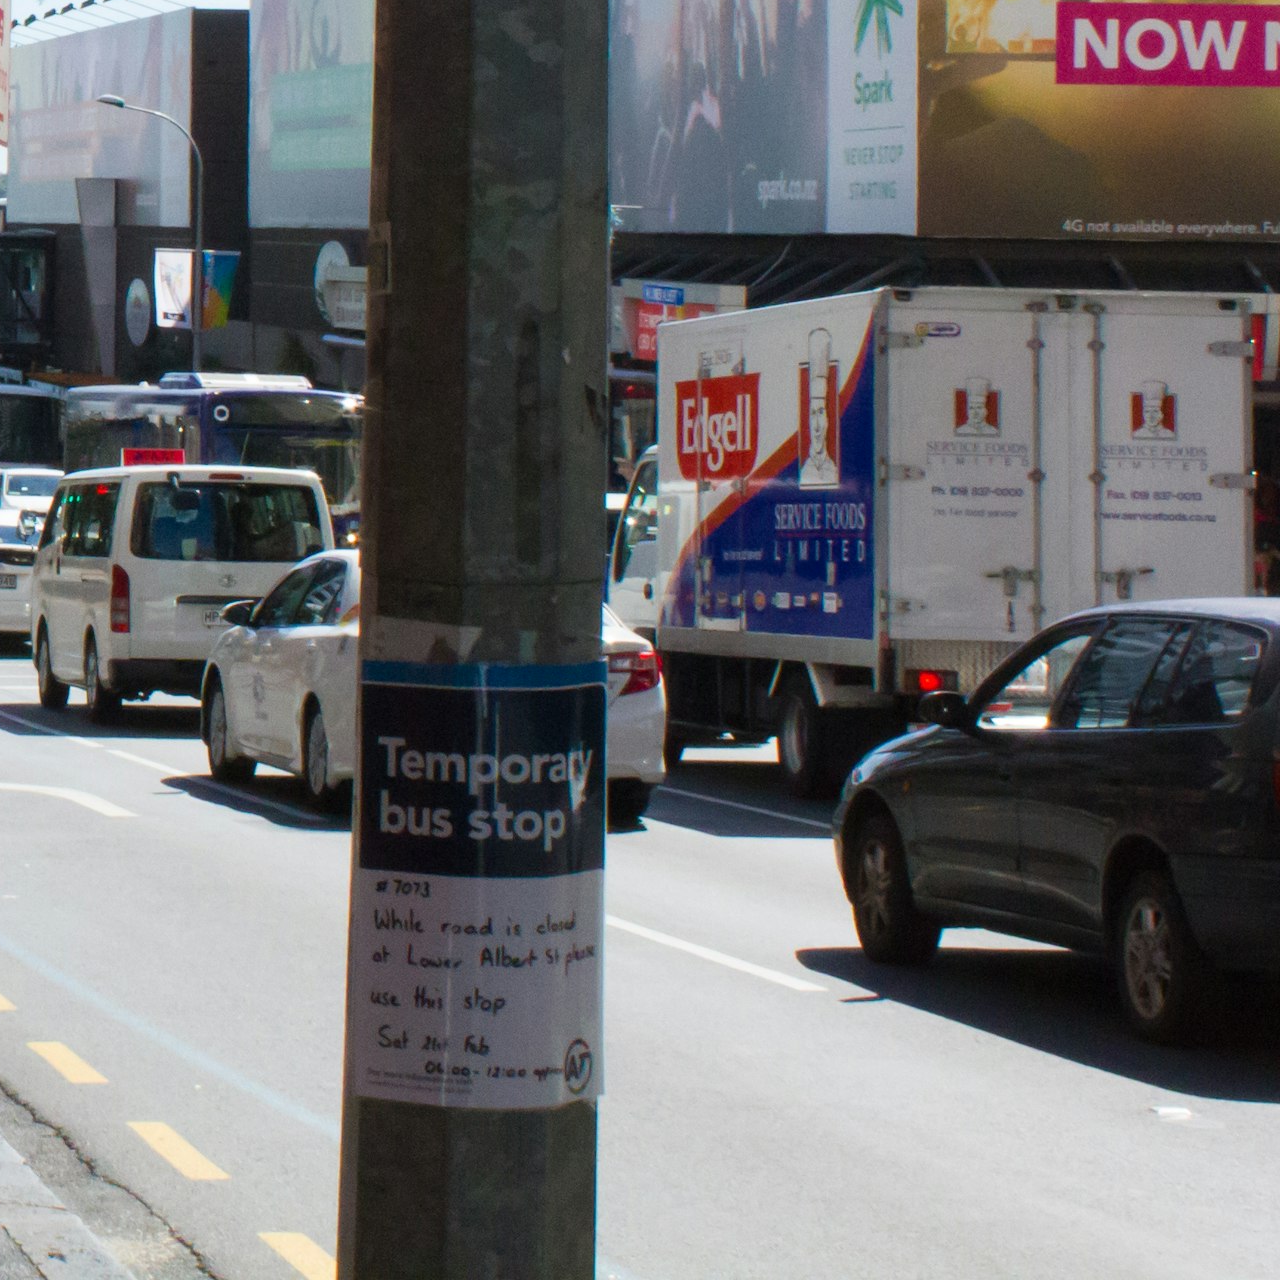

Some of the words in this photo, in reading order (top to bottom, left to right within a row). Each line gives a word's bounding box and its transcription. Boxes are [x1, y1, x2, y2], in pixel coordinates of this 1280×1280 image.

[1073, 18, 1247, 71] NOW
[854, 70, 893, 112] Spark
[845, 145, 874, 166] NEVER
[878, 144, 904, 164] STOP
[849, 181, 897, 200] STARTING
[1063, 220, 1083, 232] 4G
[1086, 221, 1110, 233] not
[1113, 220, 1173, 233] available
[1177, 221, 1260, 236] everywhere.
[682, 394, 751, 471] Edgell
[927, 441, 978, 452] SERVICE
[985, 442, 1028, 453] FOODS
[1100, 447, 1157, 457] SERVICE
[1162, 447, 1207, 457] FOODS
[927, 457, 1029, 467] LIMITED
[775, 503, 821, 530] SERVICE
[826, 503, 865, 530] FOODS
[775, 540, 865, 562] LIMITED
[378, 736, 592, 803] Temporary
[380, 790, 453, 838] bus
[468, 801, 566, 851] stop
[394, 880, 430, 897] 7073
[374, 909, 424, 933] While
[441, 918, 493, 935] road
[506, 917, 520, 936] is
[536, 911, 576, 934] closed
[372, 948, 389, 963] at
[407, 944, 462, 969] Lower
[480, 945, 537, 967] Albert
[371, 991, 401, 1007] use
[414, 986, 444, 1011] this
[464, 988, 506, 1016] stop
[378, 1025, 409, 1049] Sat
[464, 1036, 490, 1056] Feb
